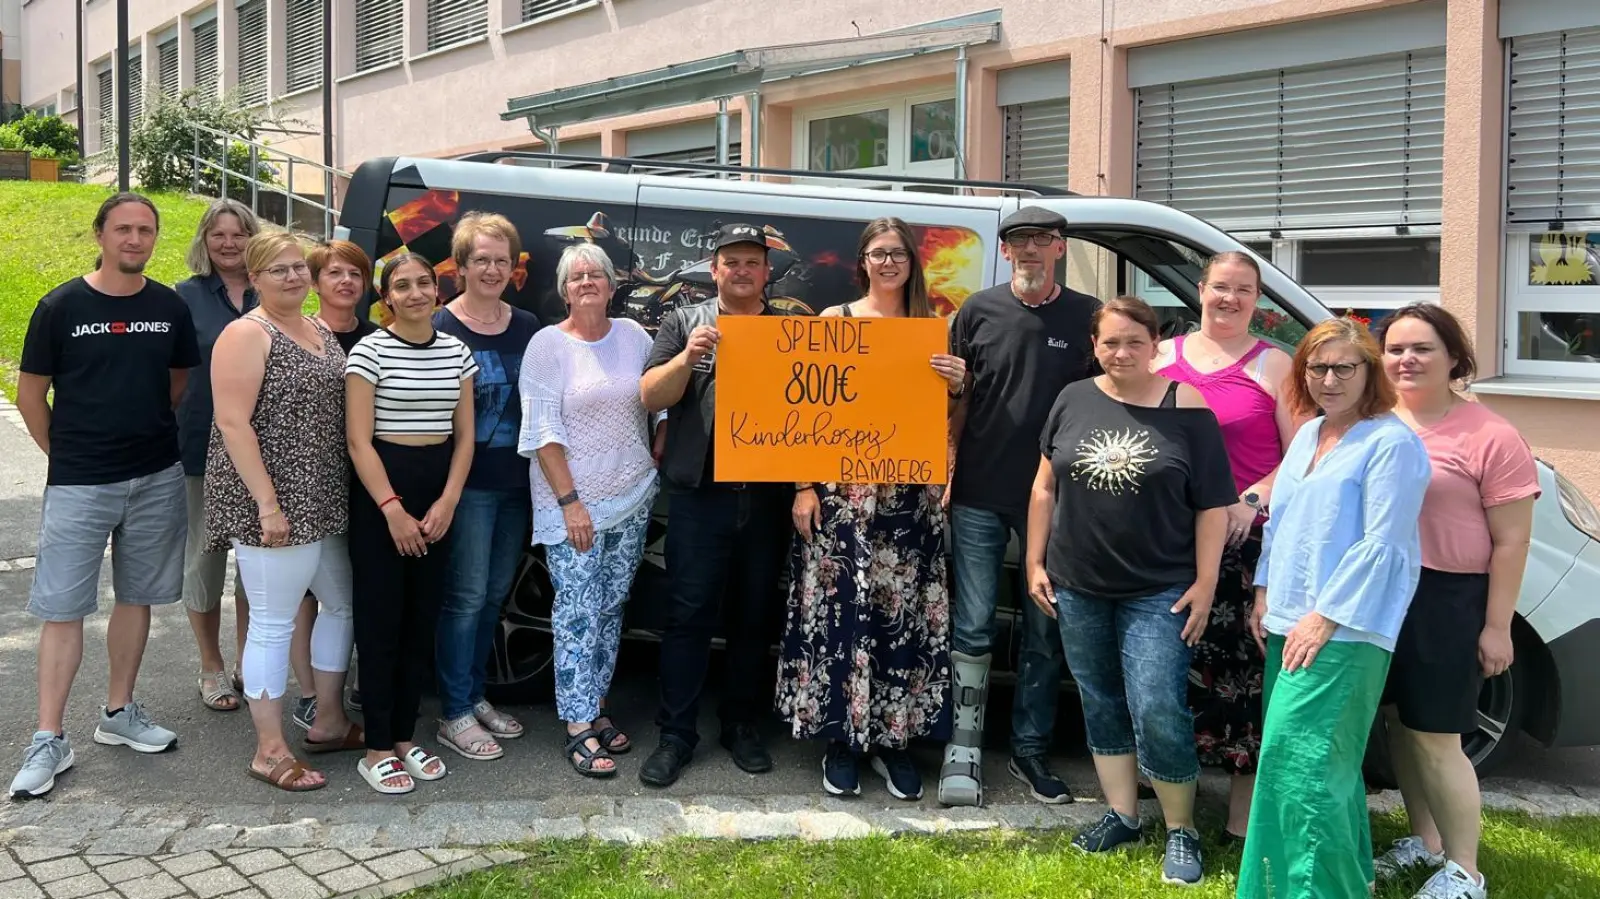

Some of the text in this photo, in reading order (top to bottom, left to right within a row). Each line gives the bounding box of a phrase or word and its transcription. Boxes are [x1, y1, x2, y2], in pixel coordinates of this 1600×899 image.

[71, 322, 111, 337] JACK
[776, 318, 872, 355] SPENDE
[785, 361, 858, 406] 800€
[730, 410, 896, 460] Kinderhospiz
[840, 456, 932, 483] BAMBERG
